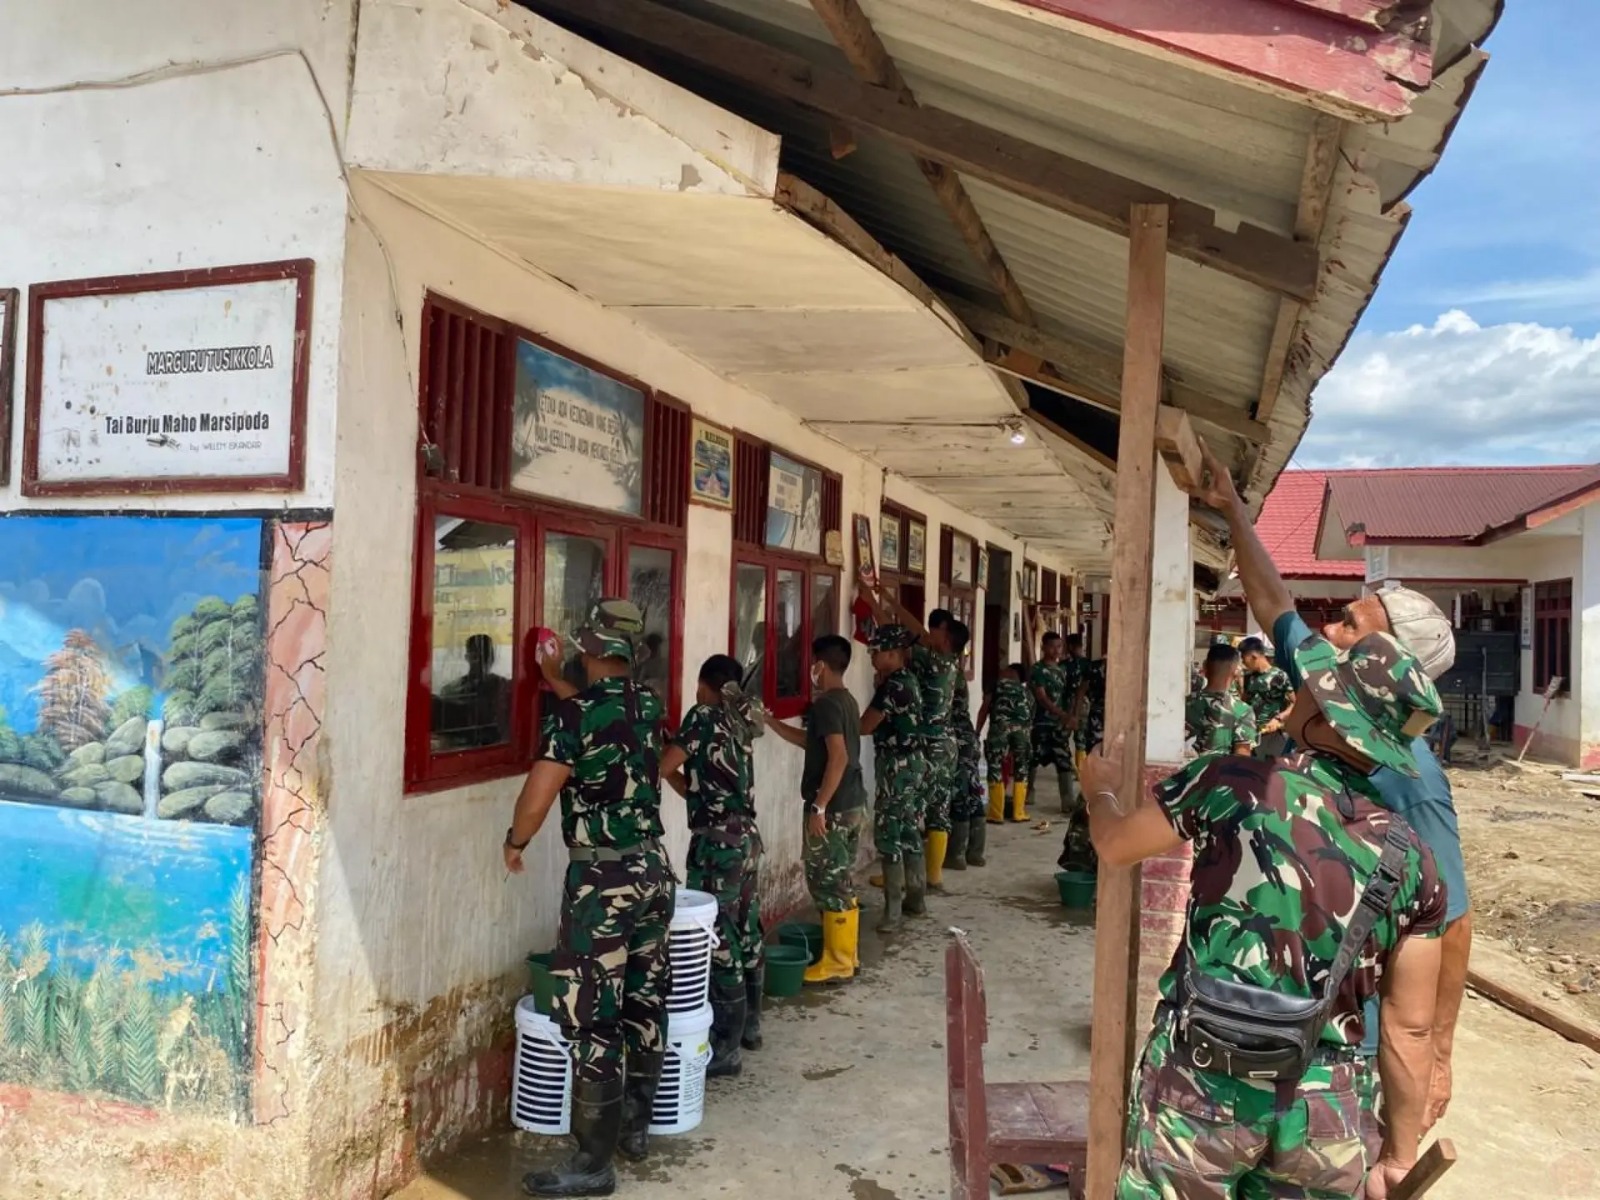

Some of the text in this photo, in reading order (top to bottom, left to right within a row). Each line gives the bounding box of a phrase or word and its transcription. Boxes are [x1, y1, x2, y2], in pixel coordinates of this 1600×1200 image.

[105, 416, 123, 434] Tai
[126, 415, 160, 436] Burju
[199, 410, 269, 434] Marsipoda
